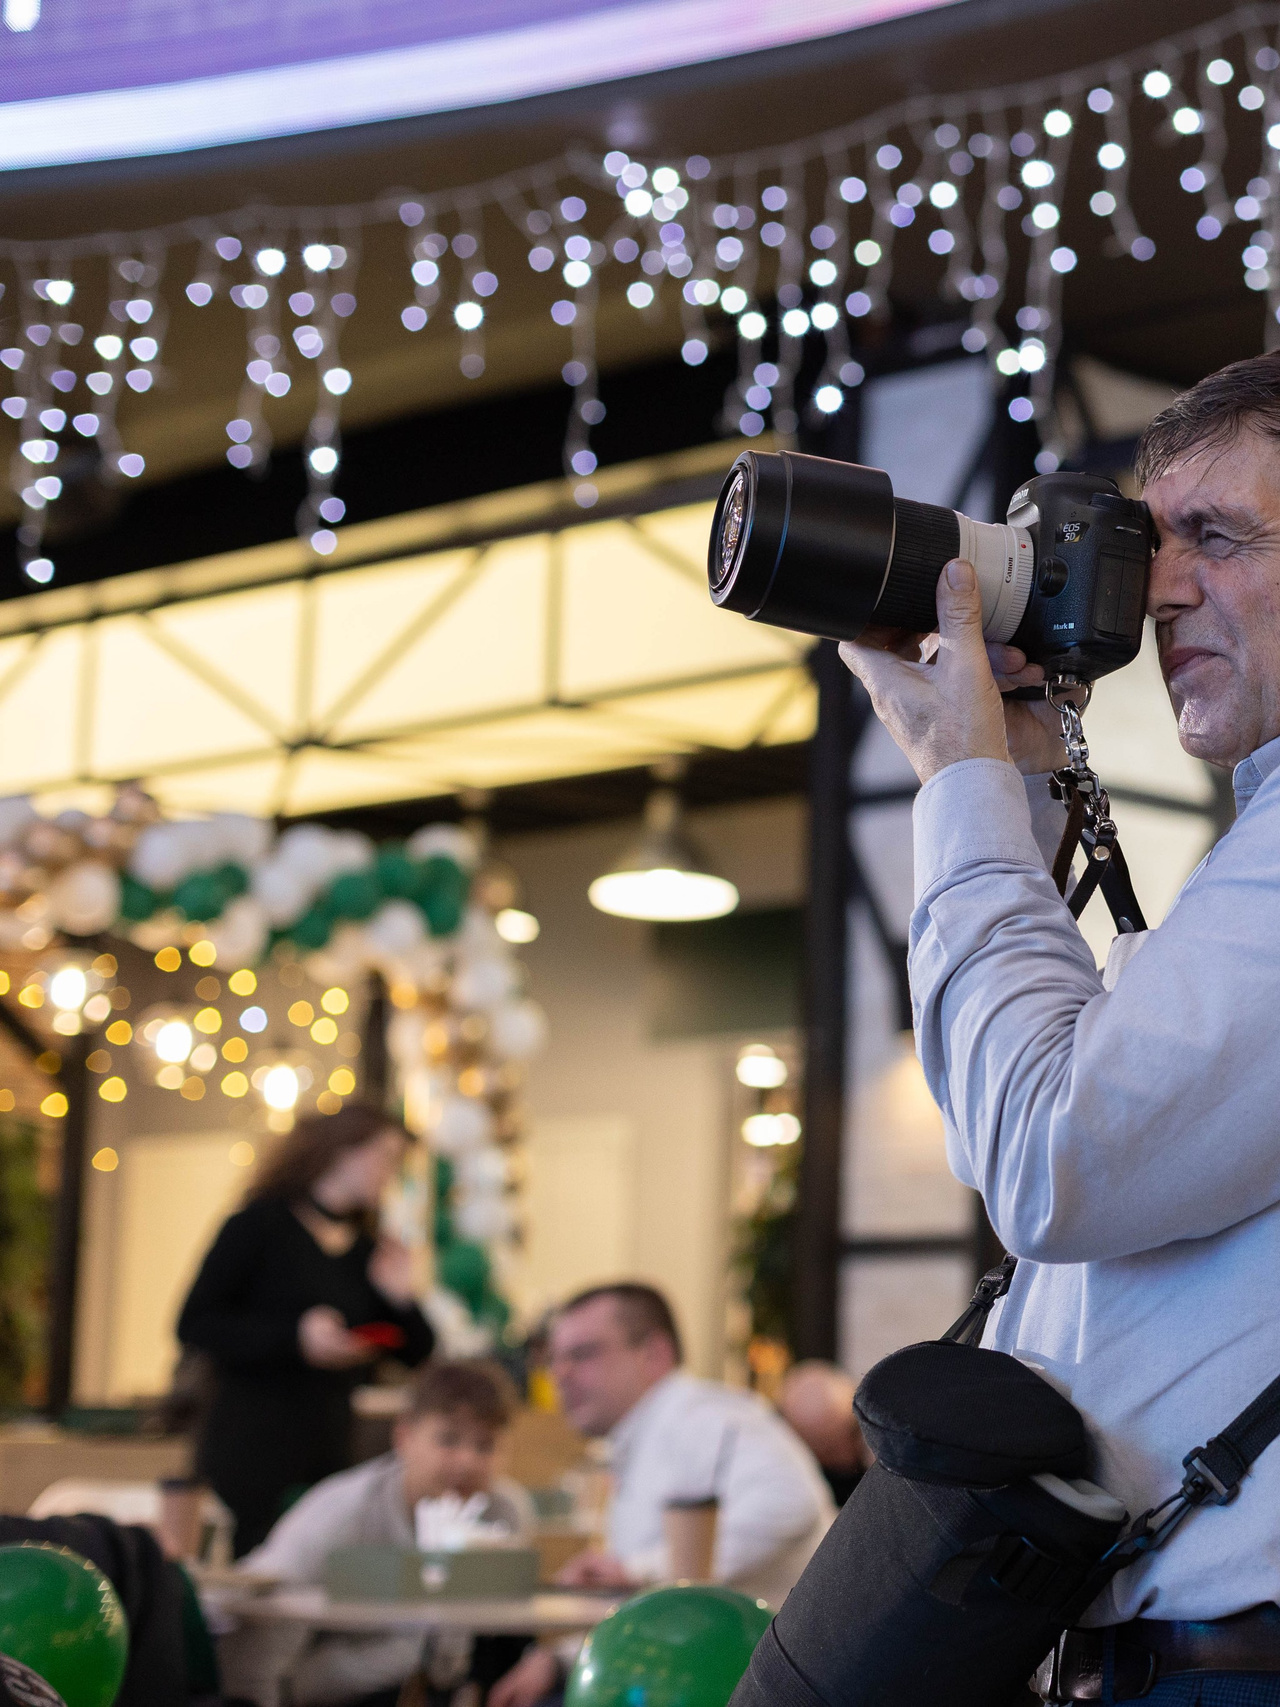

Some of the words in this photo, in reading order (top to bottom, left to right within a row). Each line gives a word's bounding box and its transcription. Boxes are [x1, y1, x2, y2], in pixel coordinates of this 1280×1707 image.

[1063, 523, 1080, 532] EOS
[1064, 533, 1076, 541] 5D
[1005, 557, 1013, 583] Canon
